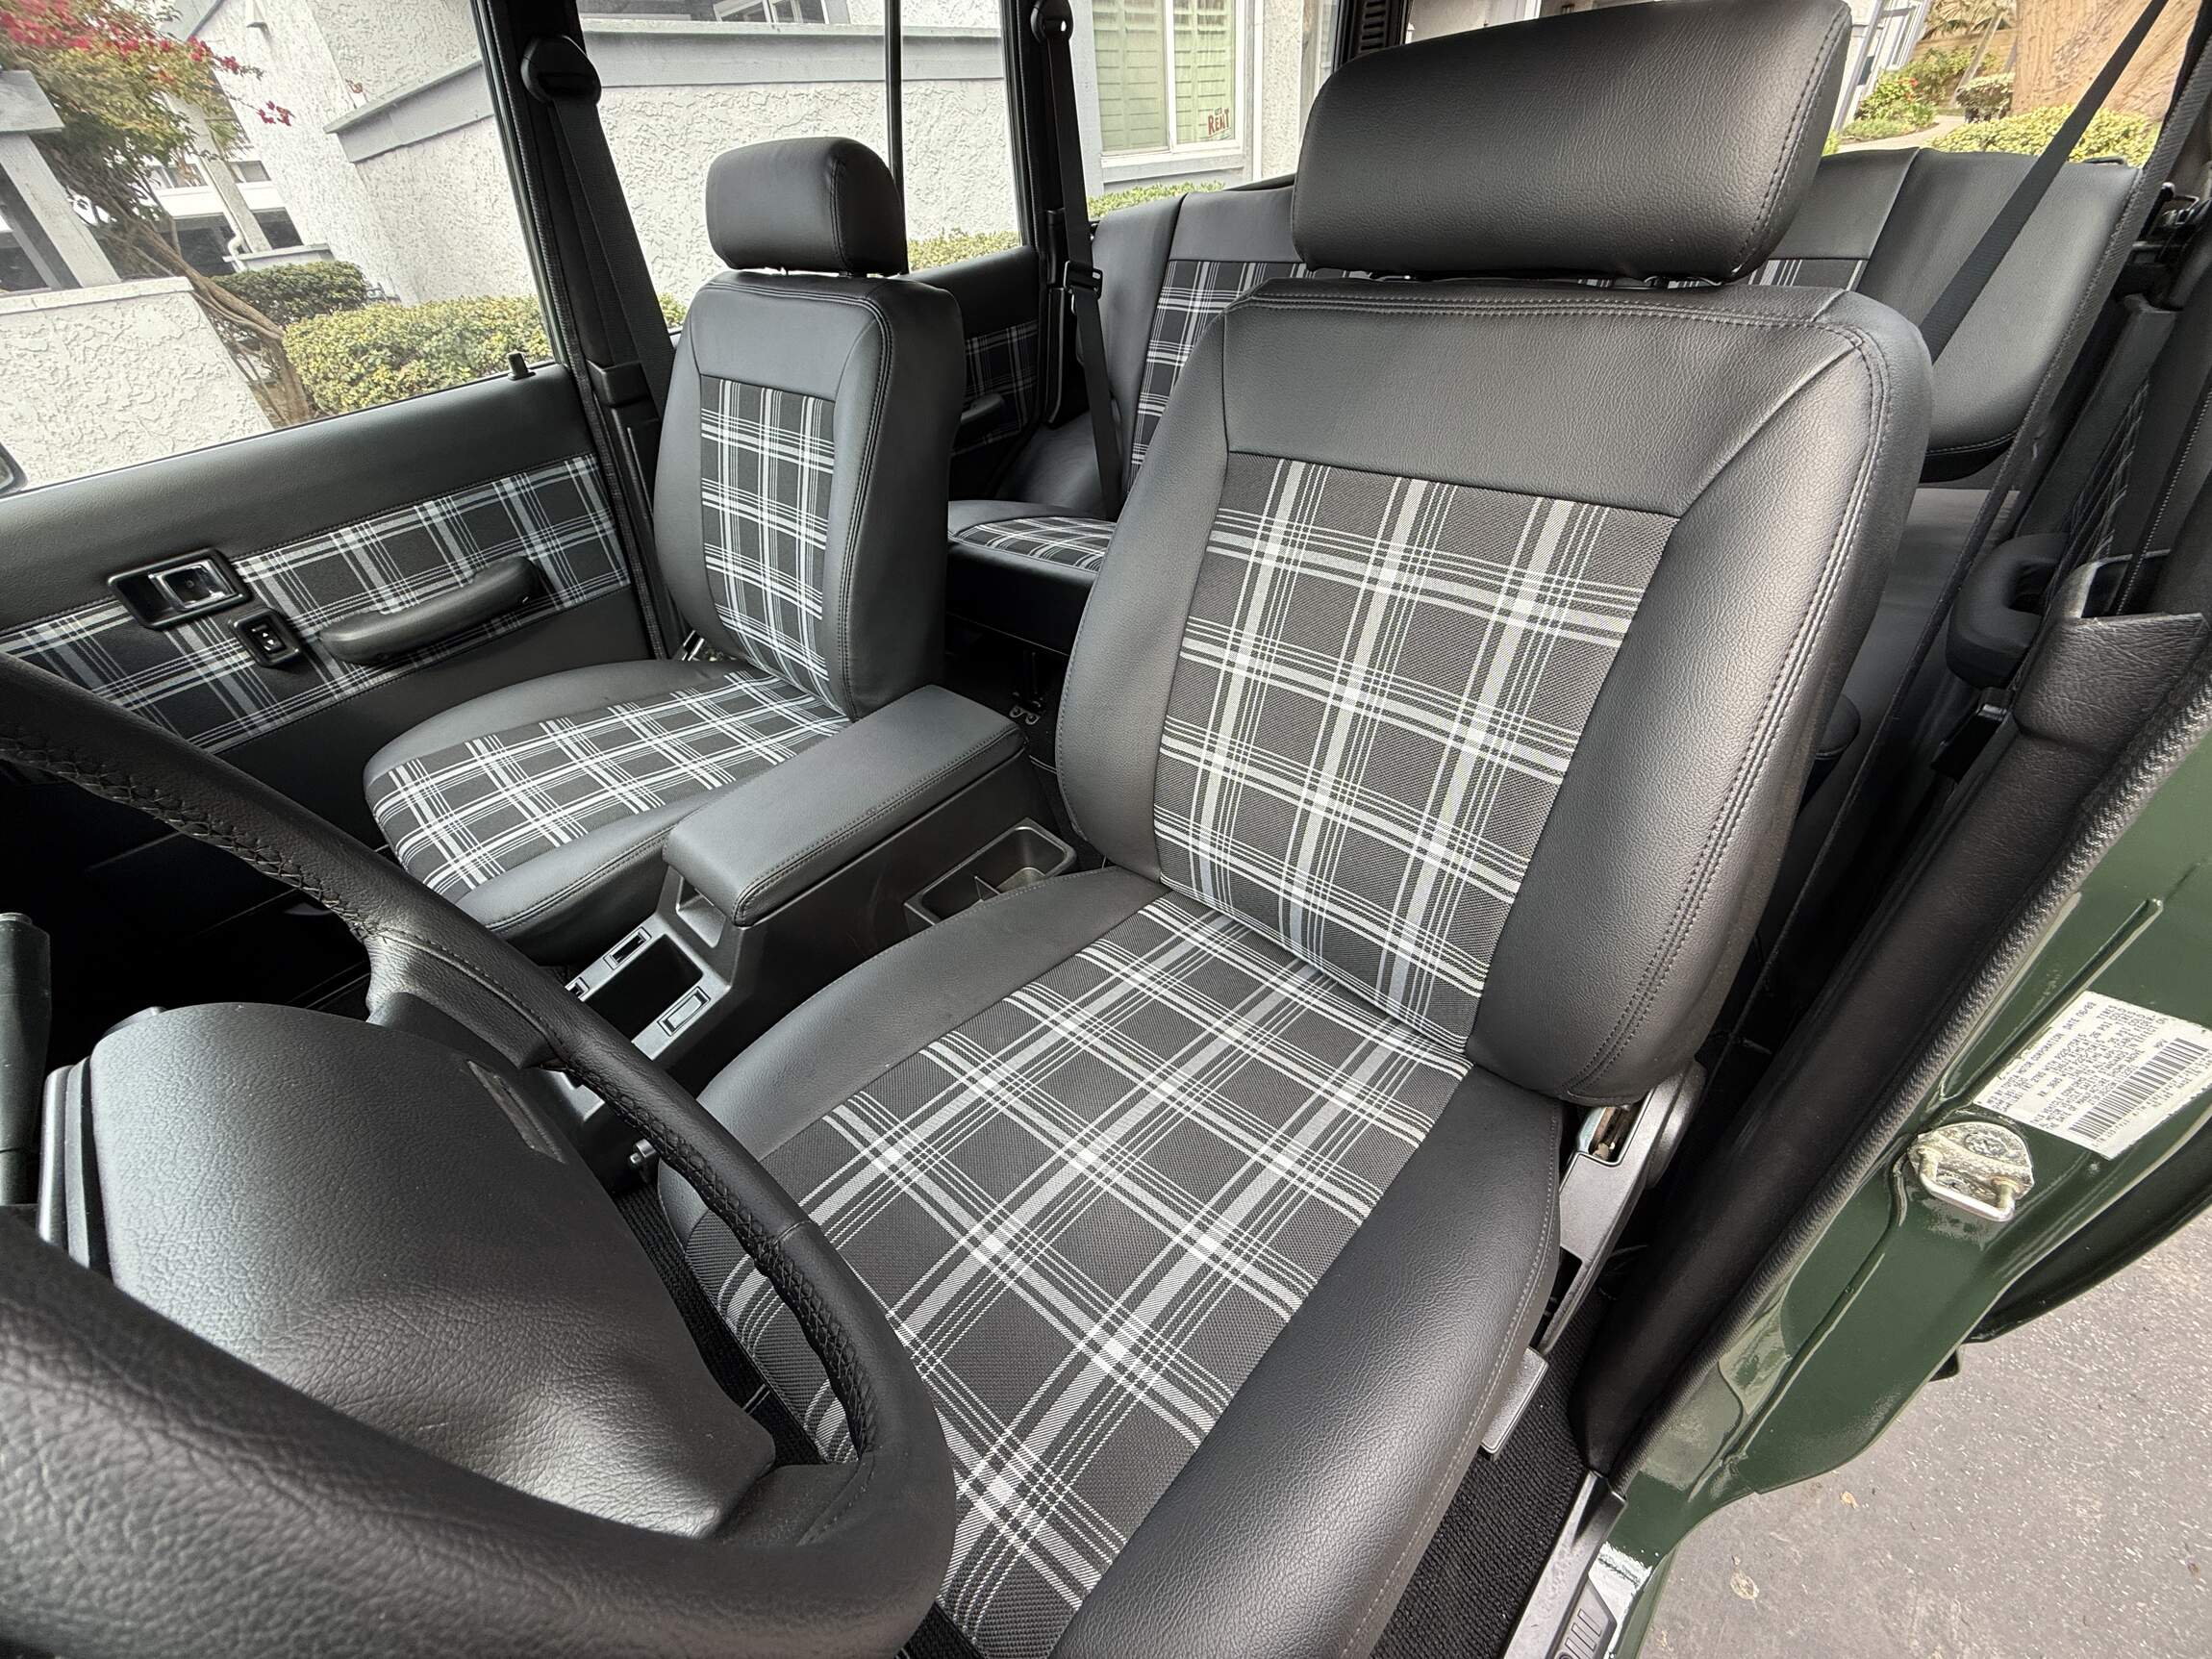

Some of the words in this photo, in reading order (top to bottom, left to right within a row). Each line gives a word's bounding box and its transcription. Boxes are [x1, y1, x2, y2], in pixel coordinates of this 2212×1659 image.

[1208, 108, 1229, 135] RENT
[2041, 1059, 2058, 1071] WITH
[2095, 1004, 2118, 1019] TIRES
[2096, 1020, 2112, 1031] PSI
[2107, 1007, 2127, 1020] COLD
[2114, 1026, 2130, 1037] PSI
[2125, 1013, 2146, 1026] COLD
[2000, 1073, 2021, 1089] TOYOTA
[2015, 1061, 2034, 1074] MOTOR
[2029, 1031, 2065, 1061] CORPORATION
[2061, 1017, 2079, 1029] DATE
[2028, 1113, 2045, 1124] THIS
[2041, 1096, 2064, 1114] VEHICLE
[2060, 1076, 2087, 1096] CONFORMS
[2091, 1060, 2105, 1068] ALL
[2101, 1032, 2137, 1059] APPLICABLE
[2043, 1108, 2062, 1121] MOTOR
[2058, 1090, 2083, 1108] VEHICLE
[2078, 1074, 2101, 1091] SAFETY
[2097, 1049, 2129, 1074] STANDARDS
[2132, 1024, 2158, 1043] EFFECT
[2053, 1111, 2071, 1121] DATE
[2074, 1077, 2110, 1105] MANUFACTURE
[2105, 1062, 2127, 1077] SHOWN
[2122, 1048, 2145, 1063] ABOVE
[2057, 1065, 2075, 1077] WITH
